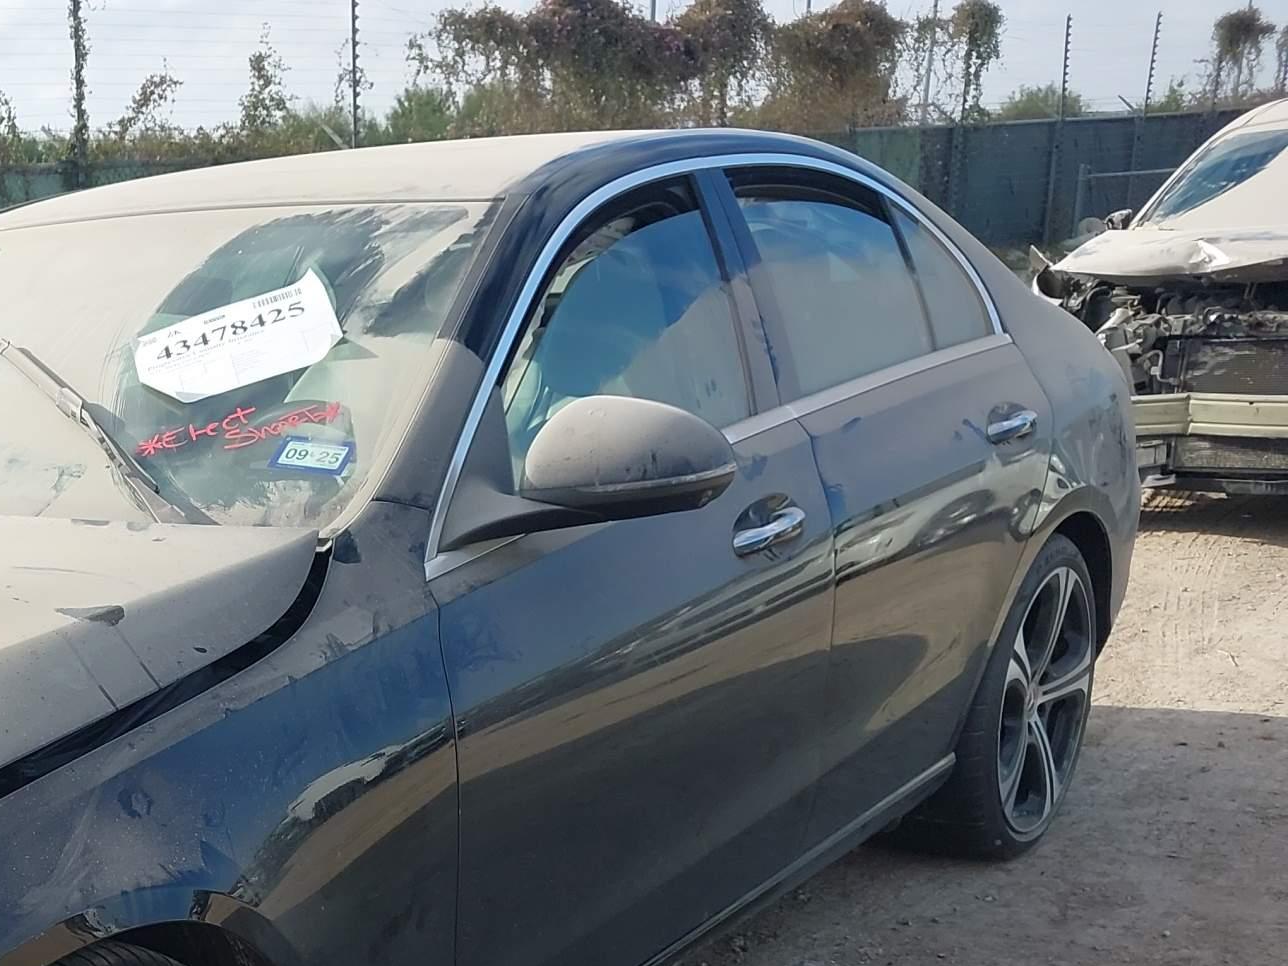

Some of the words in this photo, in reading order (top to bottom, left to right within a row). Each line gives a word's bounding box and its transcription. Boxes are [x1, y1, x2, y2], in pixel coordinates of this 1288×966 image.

[157, 301, 305, 359] 43478425
[285, 447, 309, 461] 09
[315, 451, 342, 465] 25
